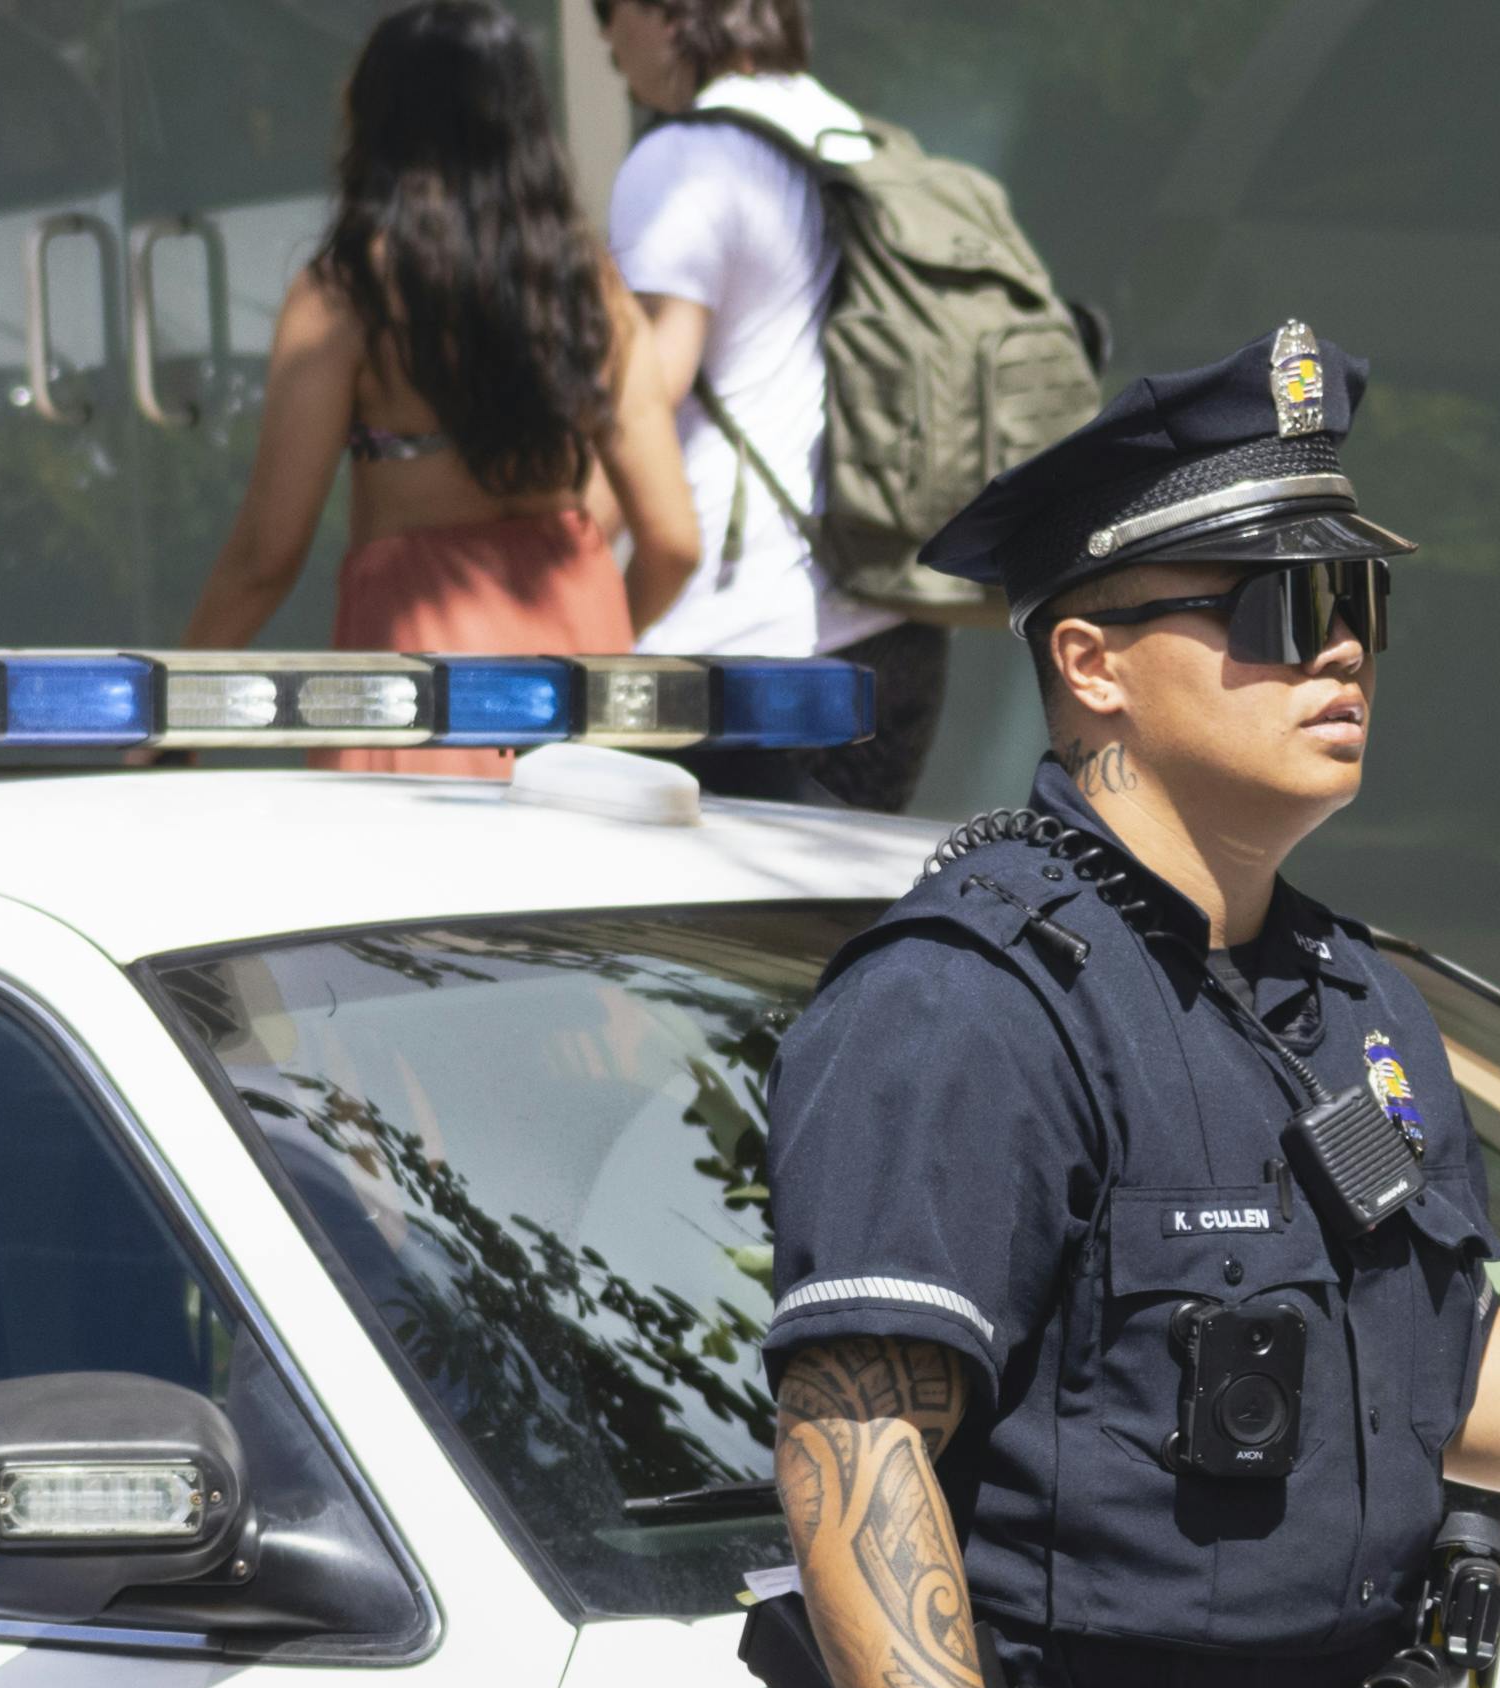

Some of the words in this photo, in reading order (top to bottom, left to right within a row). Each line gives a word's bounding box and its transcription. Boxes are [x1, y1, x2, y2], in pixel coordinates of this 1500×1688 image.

[1175, 1211, 1192, 1231] K.
[1200, 1208, 1270, 1230] CULLEN
[1236, 1451, 1263, 1460] AXON
